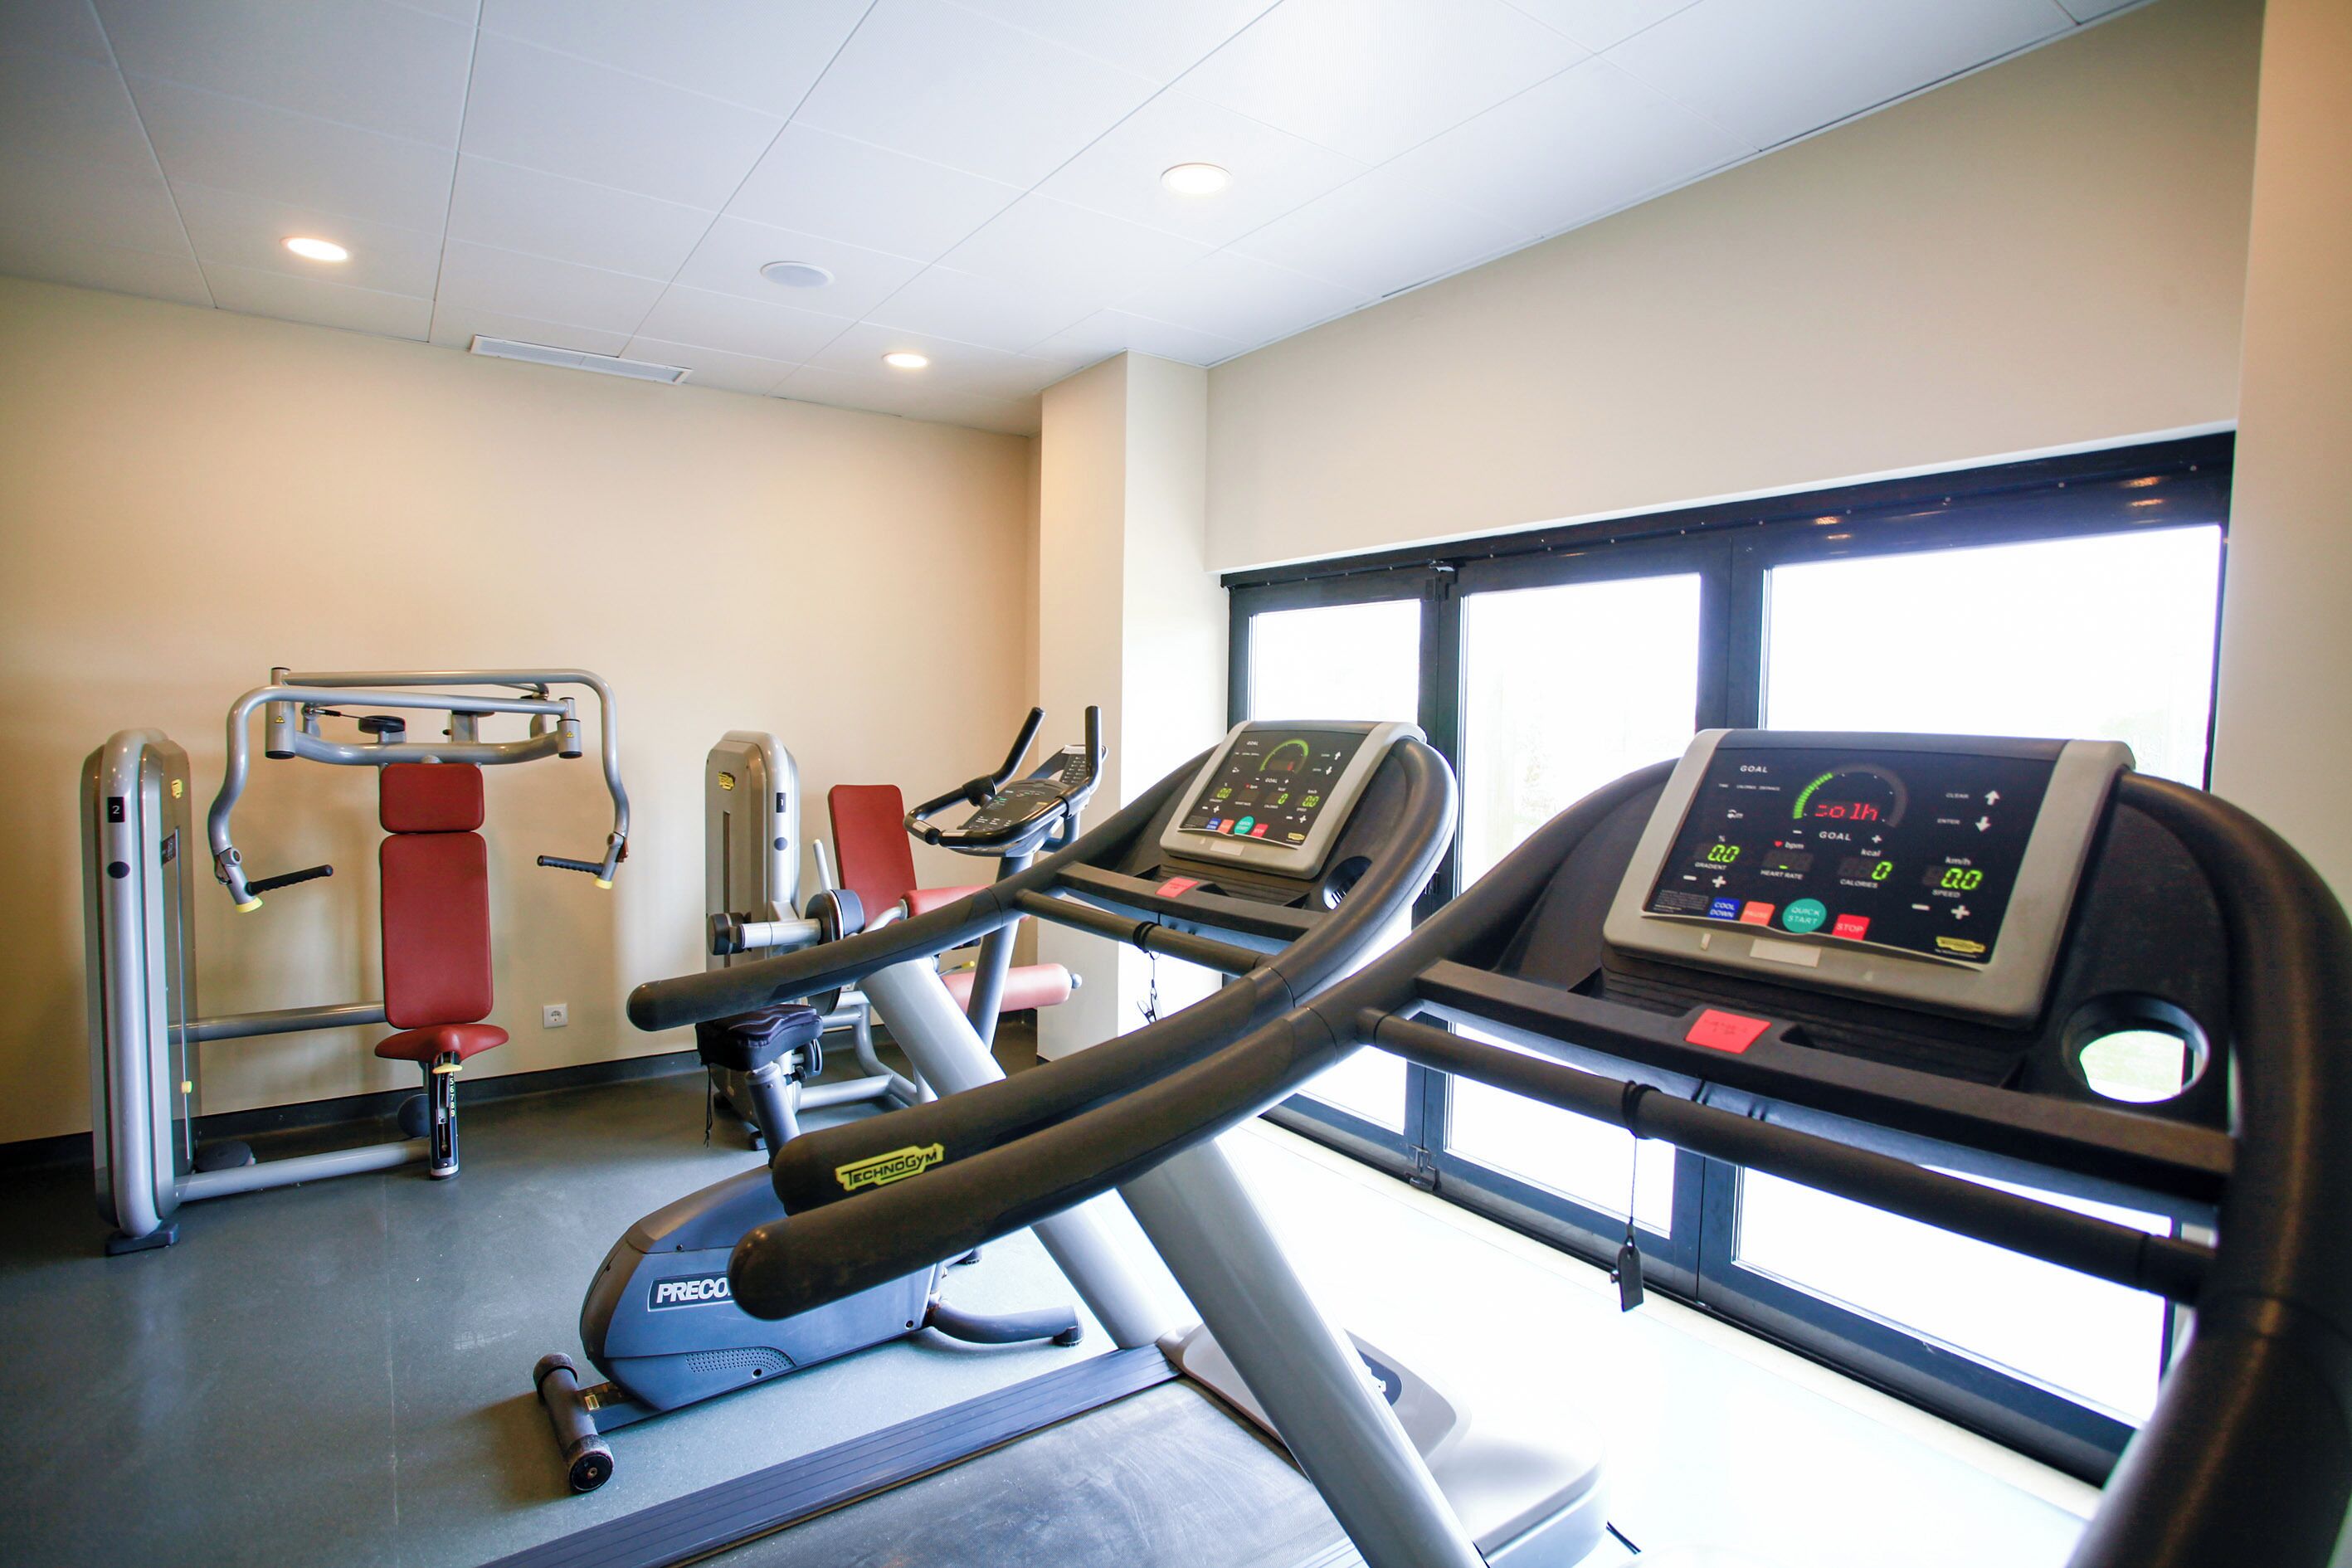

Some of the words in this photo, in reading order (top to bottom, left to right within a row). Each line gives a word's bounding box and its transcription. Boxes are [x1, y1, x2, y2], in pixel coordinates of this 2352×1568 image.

[1740, 765, 1768, 773] GOAL
[781, 798, 784, 806] 1
[112, 805, 120, 815] 2
[1819, 830, 1852, 840] GOAL
[1785, 841, 1804, 850] bpm
[1861, 848, 1881, 857] kcal
[1694, 861, 1727, 871] GRADIENT
[1945, 856, 1972, 866] km/h
[1760, 869, 1784, 878] HEART
[1785, 872, 1804, 880] RATE
[1871, 861, 1893, 881] 0
[1839, 879, 1878, 889] CALORIES
[1932, 889, 1961, 898] SPEED
[1714, 901, 1736, 911] COOL
[1709, 908, 1735, 918] DOWN
[1790, 906, 1820, 917] QUICK
[1787, 914, 1819, 925] START
[1835, 923, 1865, 933] STOP
[656, 1277, 731, 1303] PRECO
